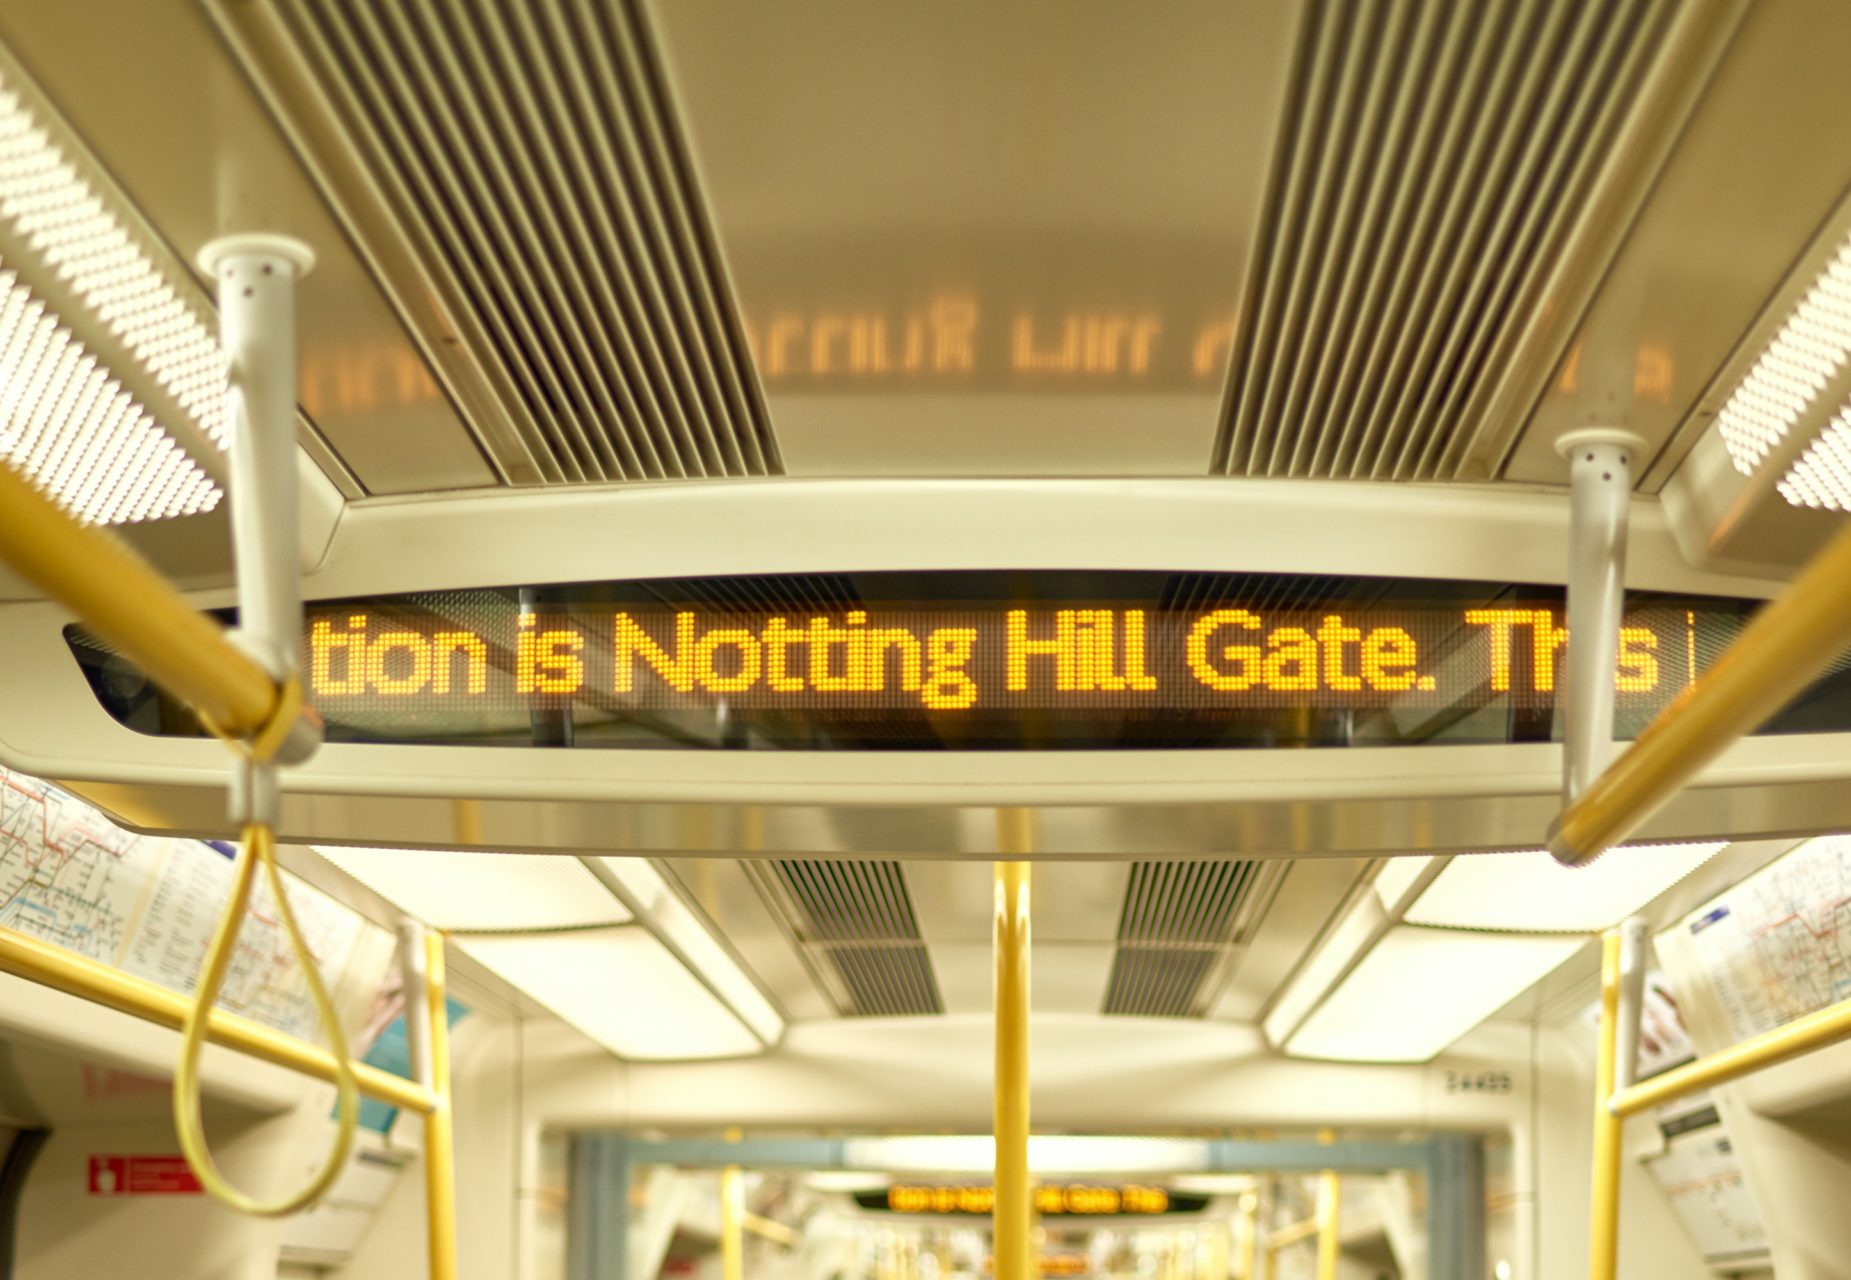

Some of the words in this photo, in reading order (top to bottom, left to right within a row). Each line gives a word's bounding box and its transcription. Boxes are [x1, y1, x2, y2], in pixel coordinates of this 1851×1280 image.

[311, 614, 487, 695] tion
[516, 612, 584, 694] is
[614, 610, 978, 710] Notting
[1006, 609, 1158, 691] Hill
[1186, 609, 1437, 691] Gate.
[1464, 609, 1659, 693] Ths
